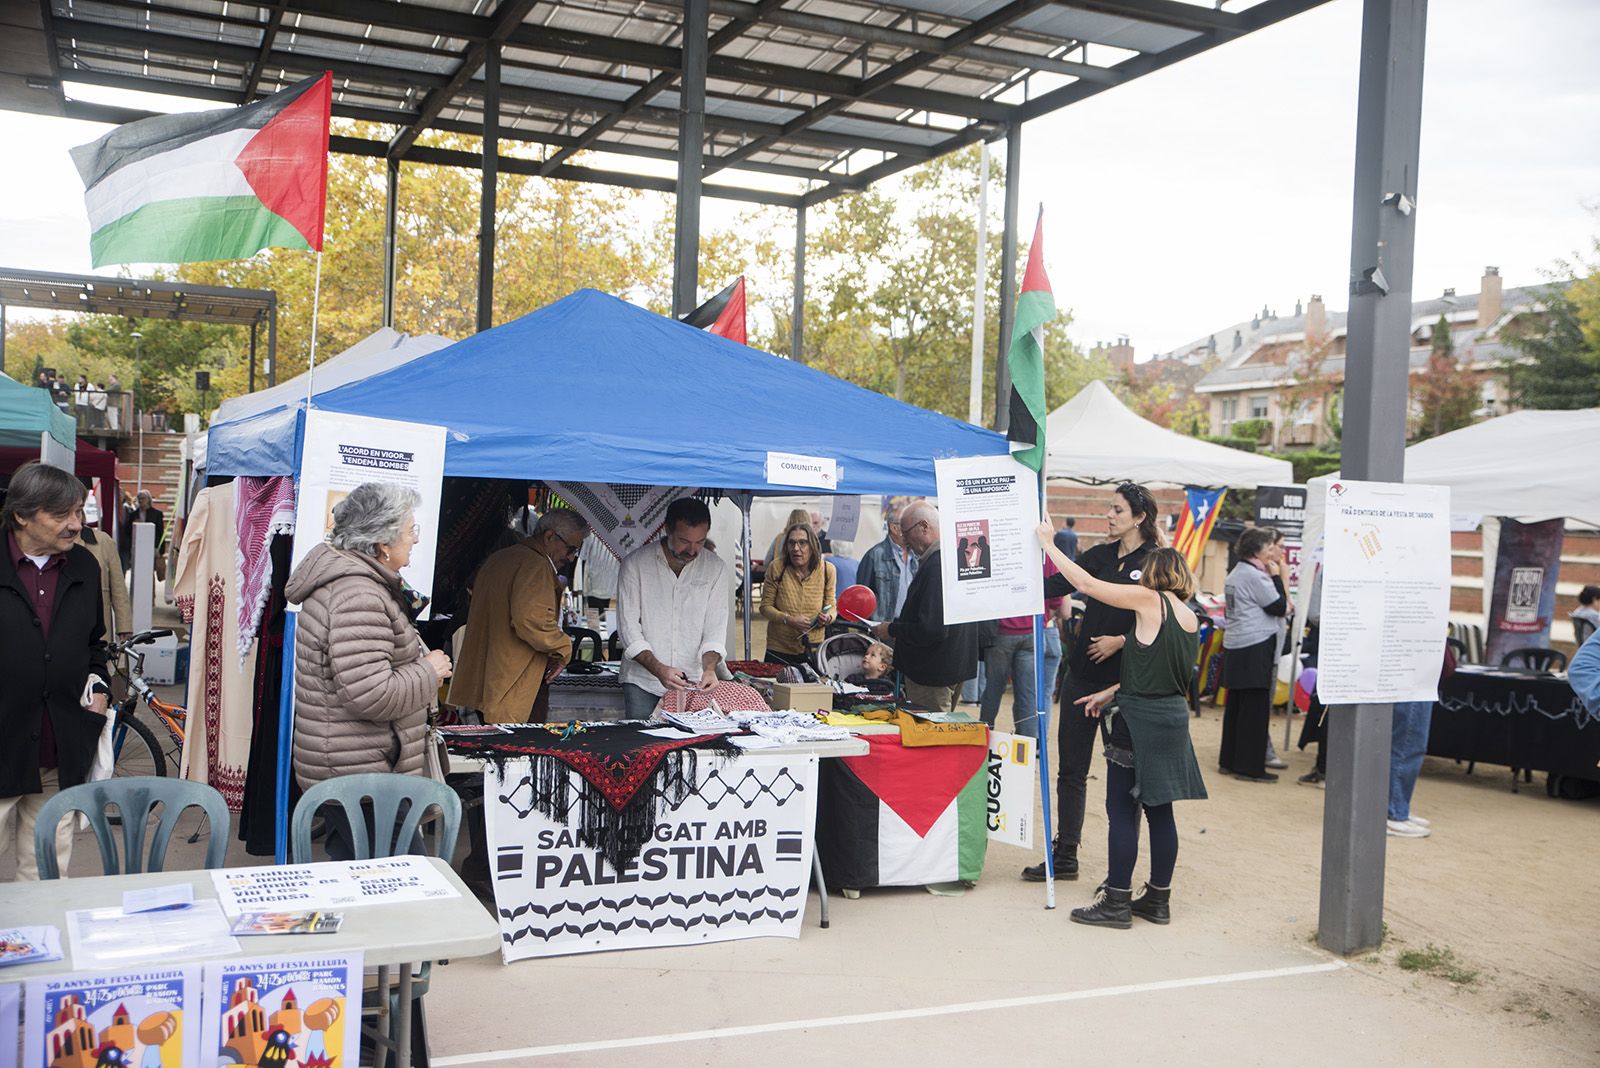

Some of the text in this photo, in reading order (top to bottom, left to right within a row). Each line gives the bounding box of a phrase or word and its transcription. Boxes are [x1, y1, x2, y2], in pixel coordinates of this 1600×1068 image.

[370, 449, 380, 458] EN
[379, 460, 409, 470] BOMBES
[781, 462, 822, 472] COMUNITAT
[970, 486, 982, 494] UNA
[986, 749, 1002, 831] CUGAT
[714, 819, 767, 840] AMB
[536, 843, 764, 889] PALESTINA
[239, 963, 263, 971] ANYS
[266, 962, 277, 970] DE
[281, 960, 309, 969] FESTA
[316, 958, 348, 967] LLUITA
[312, 970, 333, 978] PARC
[47, 981, 60, 990] 50
[64, 979, 92, 988] ANYS
[94, 976, 107, 985] DE
[111, 974, 141, 984] FESTA
[149, 970, 184, 980] LLUITA
[313, 976, 342, 984] RAMON
[146, 982, 169, 991] PARC
